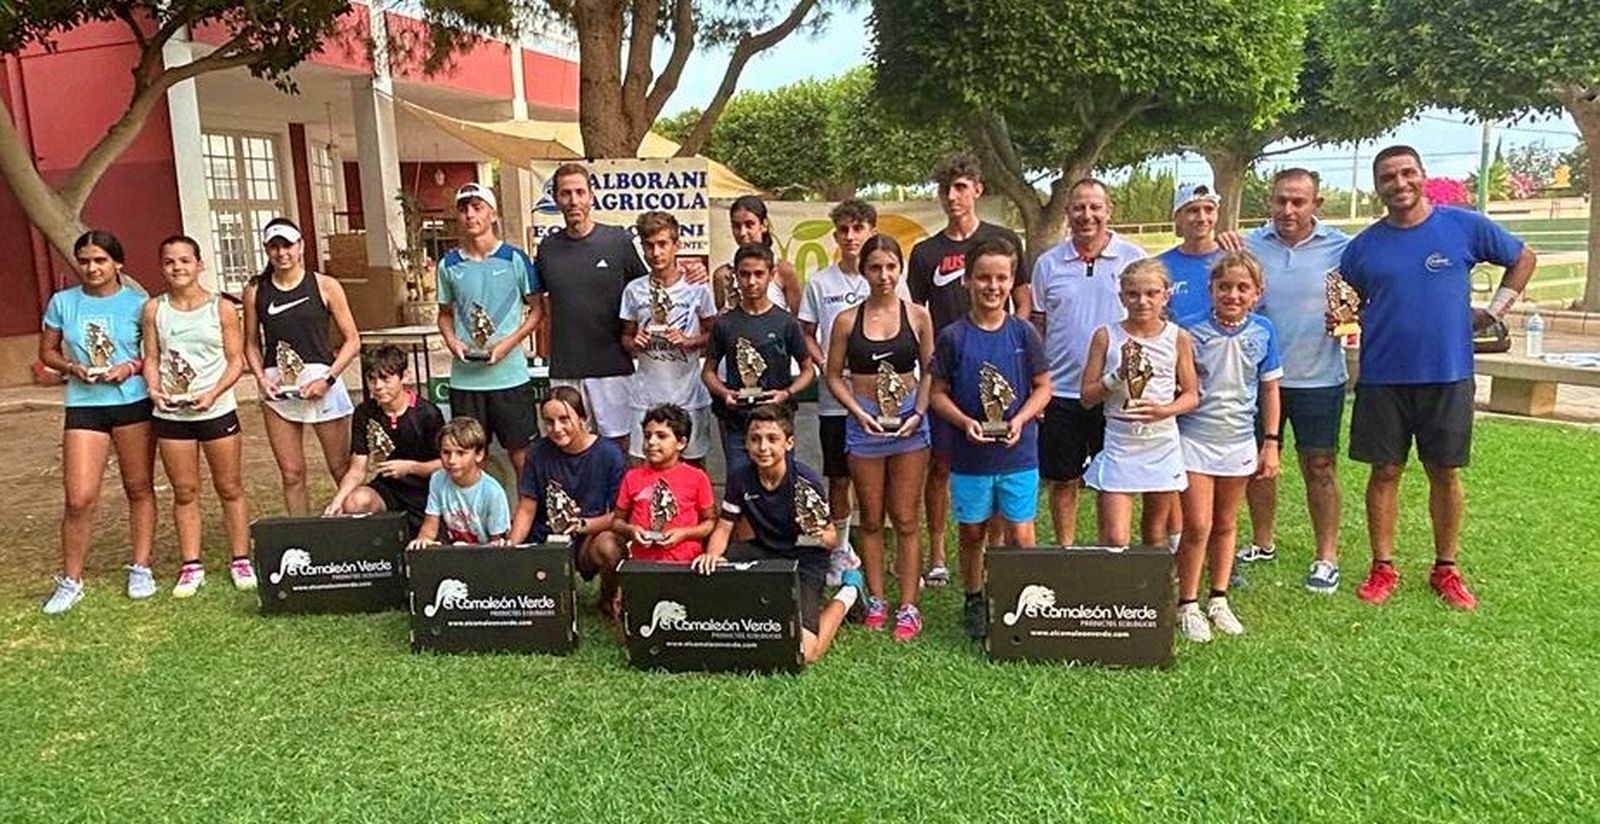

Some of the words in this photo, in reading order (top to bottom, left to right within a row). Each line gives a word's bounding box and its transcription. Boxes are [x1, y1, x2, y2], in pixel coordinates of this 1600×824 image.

[590, 171, 707, 190] ALBORANI
[592, 192, 707, 210] AGRICOLA
[942, 255, 966, 271] JUS
[299, 561, 356, 576] Camaleón
[356, 559, 392, 572] Verde
[455, 595, 517, 610] Camaleón
[516, 595, 555, 609] Verde
[1041, 603, 1112, 619] Camaleón
[1112, 604, 1158, 620] Verde
[673, 618, 740, 632] Camaleón
[740, 618, 782, 632] Verde
